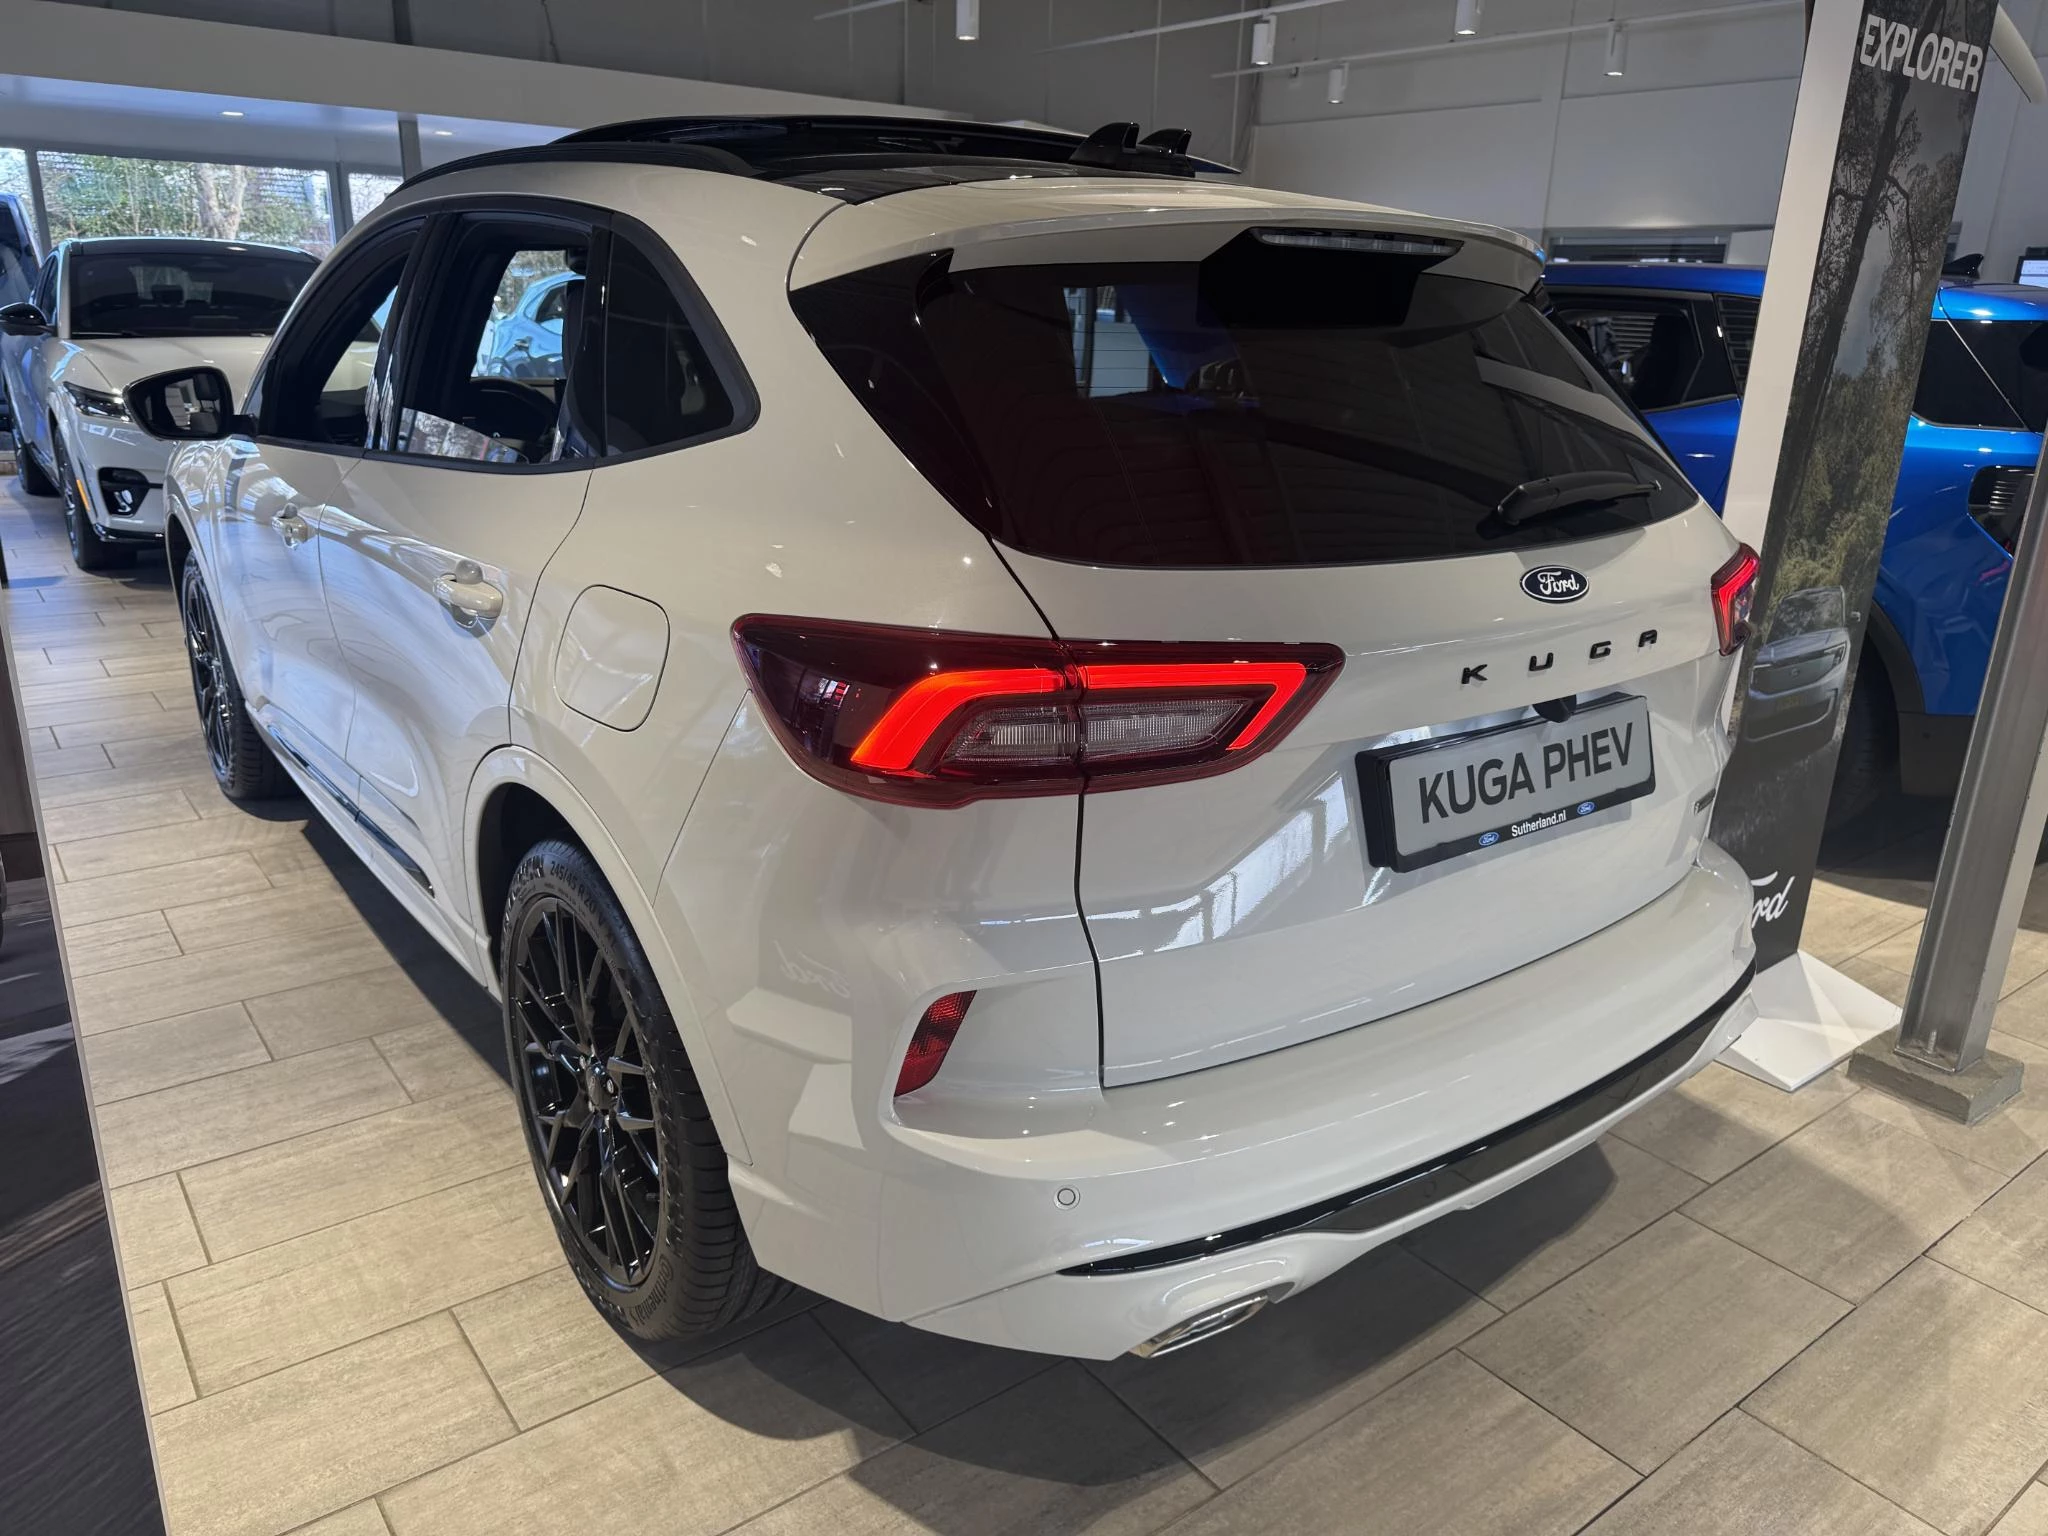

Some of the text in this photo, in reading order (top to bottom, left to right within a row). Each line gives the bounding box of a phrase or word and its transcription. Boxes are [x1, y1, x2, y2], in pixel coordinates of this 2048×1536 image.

[1859, 13, 1984, 93] EXPLORER
[1537, 570, 1580, 595] Ford
[1461, 629, 1658, 685] KUGA
[1419, 722, 1633, 824] KUGA PHEV
[1511, 809, 1567, 838] Sutherland.nl
[1750, 871, 1795, 929] rd
